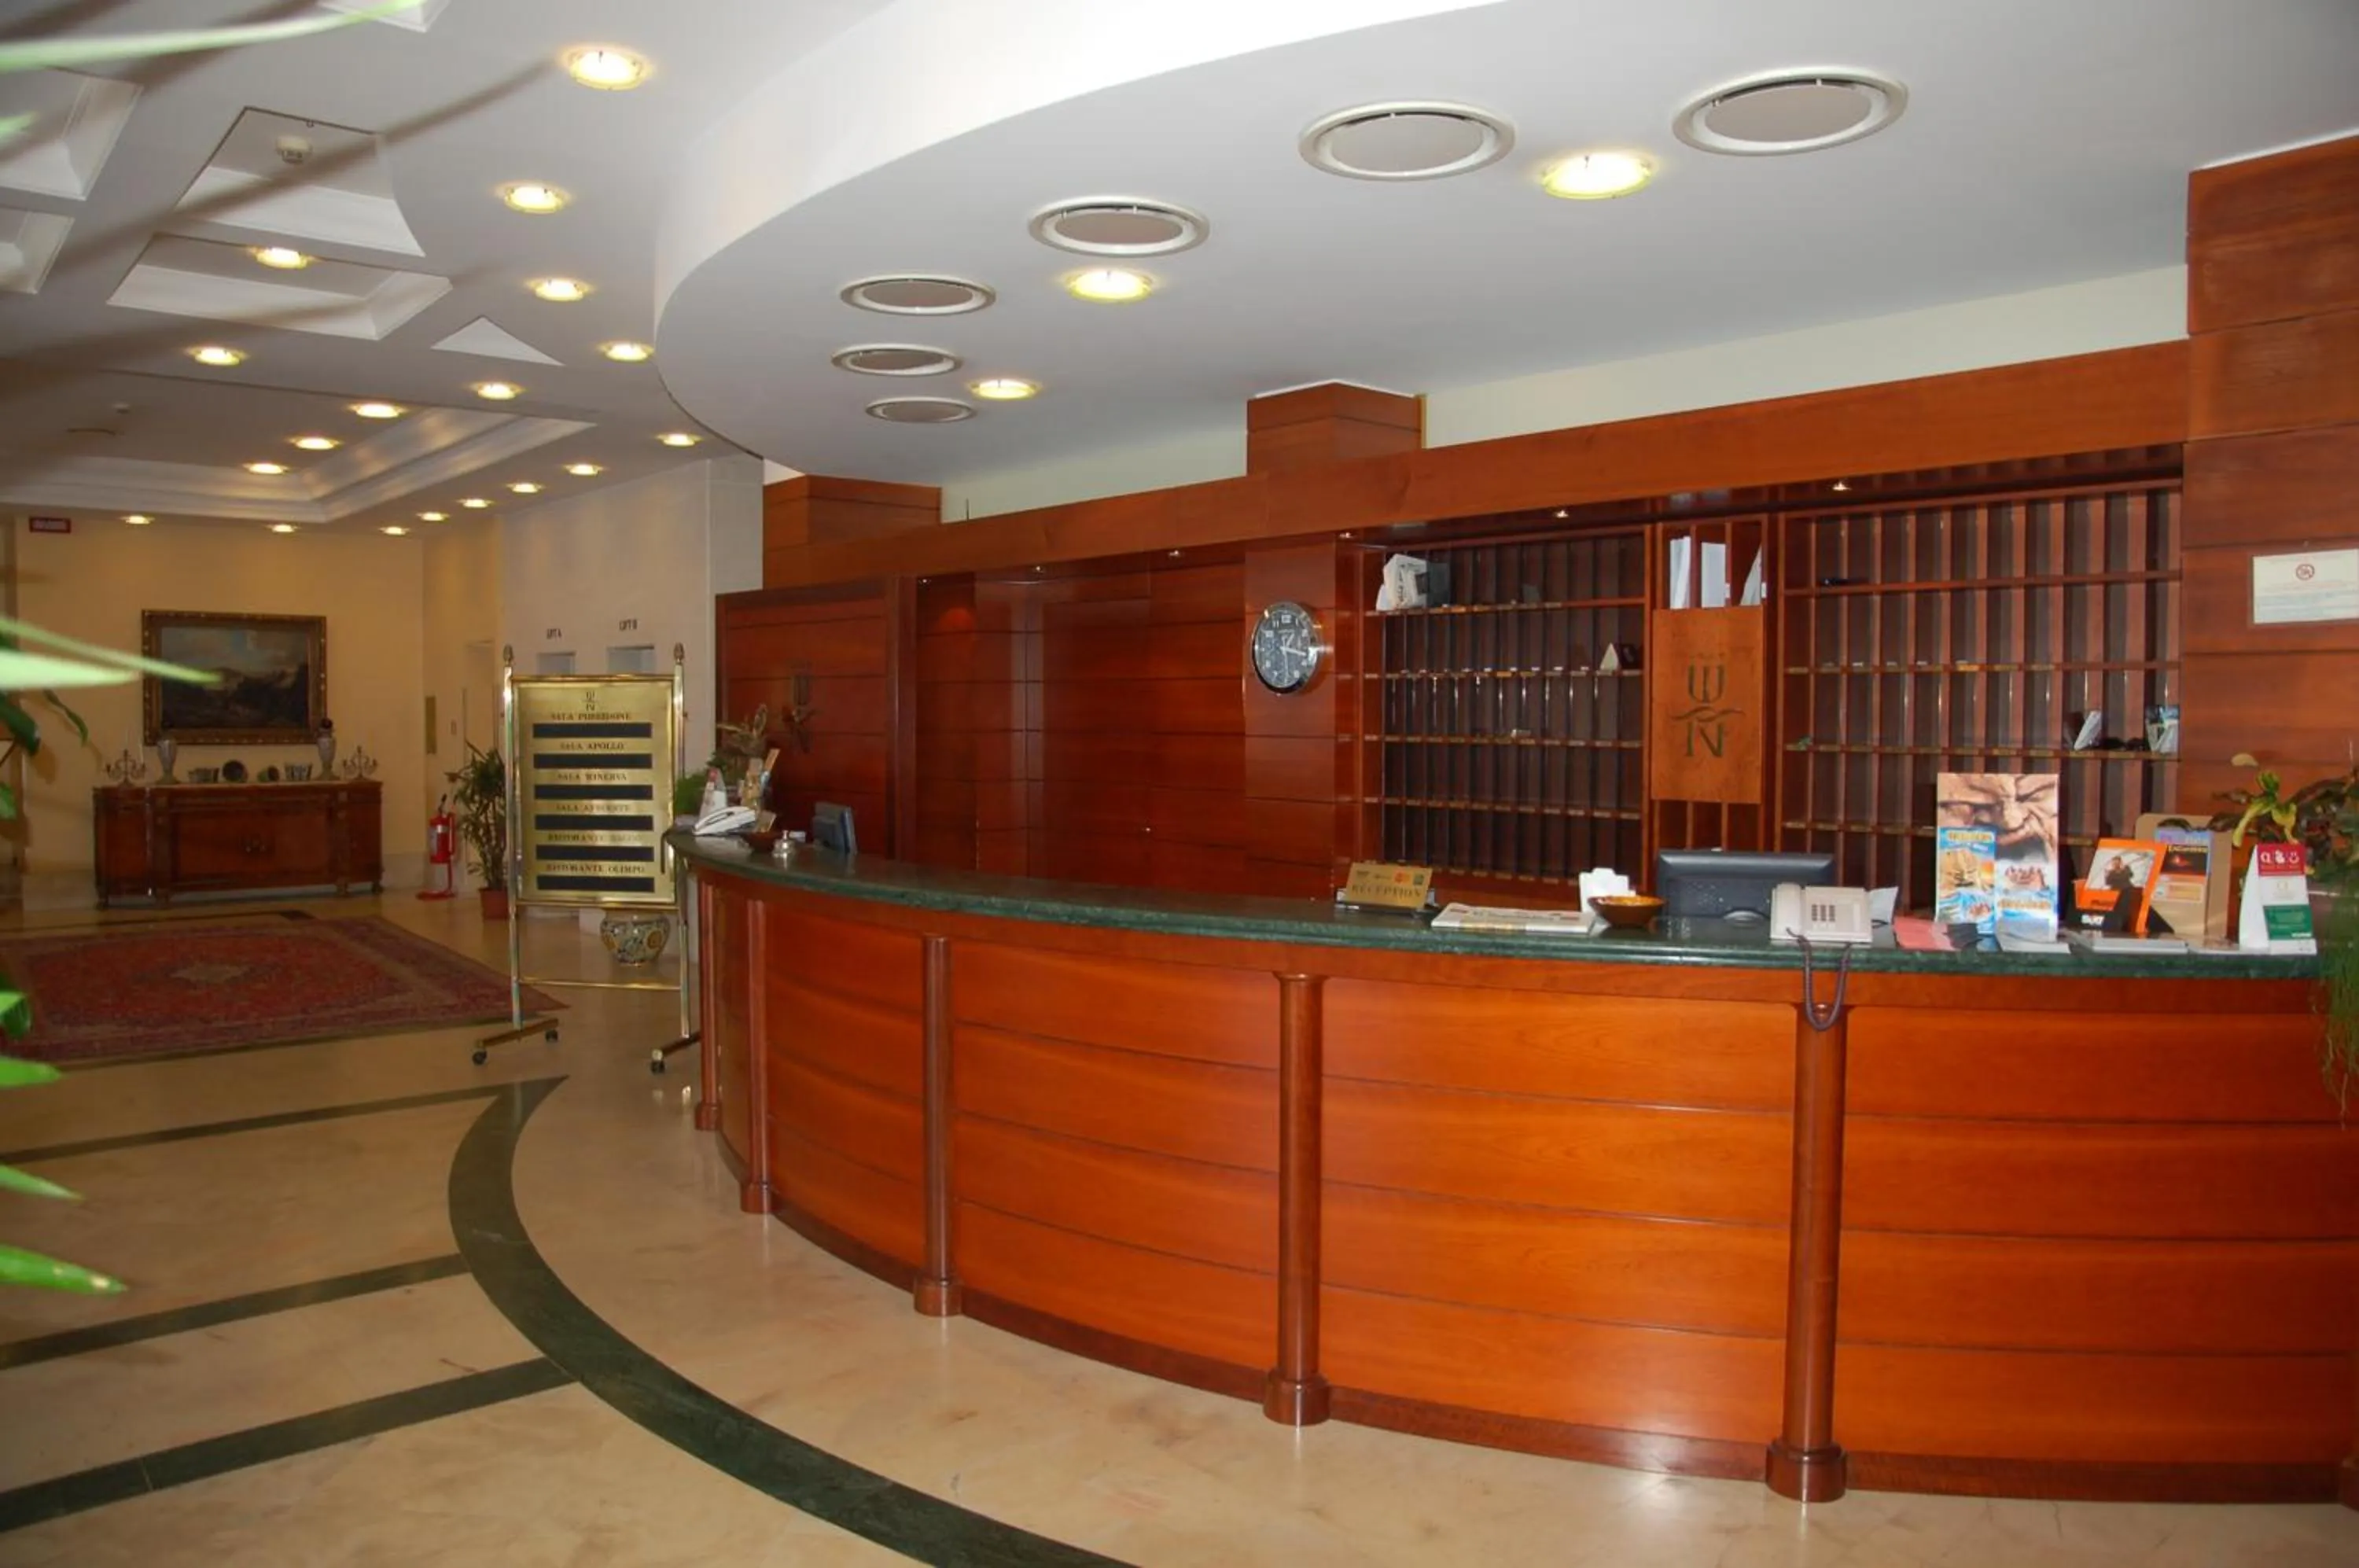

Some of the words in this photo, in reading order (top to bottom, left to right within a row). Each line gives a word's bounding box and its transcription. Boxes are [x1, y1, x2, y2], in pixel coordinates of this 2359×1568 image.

[587, 742, 624, 750] APOLLO
[547, 863, 602, 872] RISTORANTE
[608, 864, 645, 873] OLIMPO
[1351, 884, 1422, 898] RECEPTION
